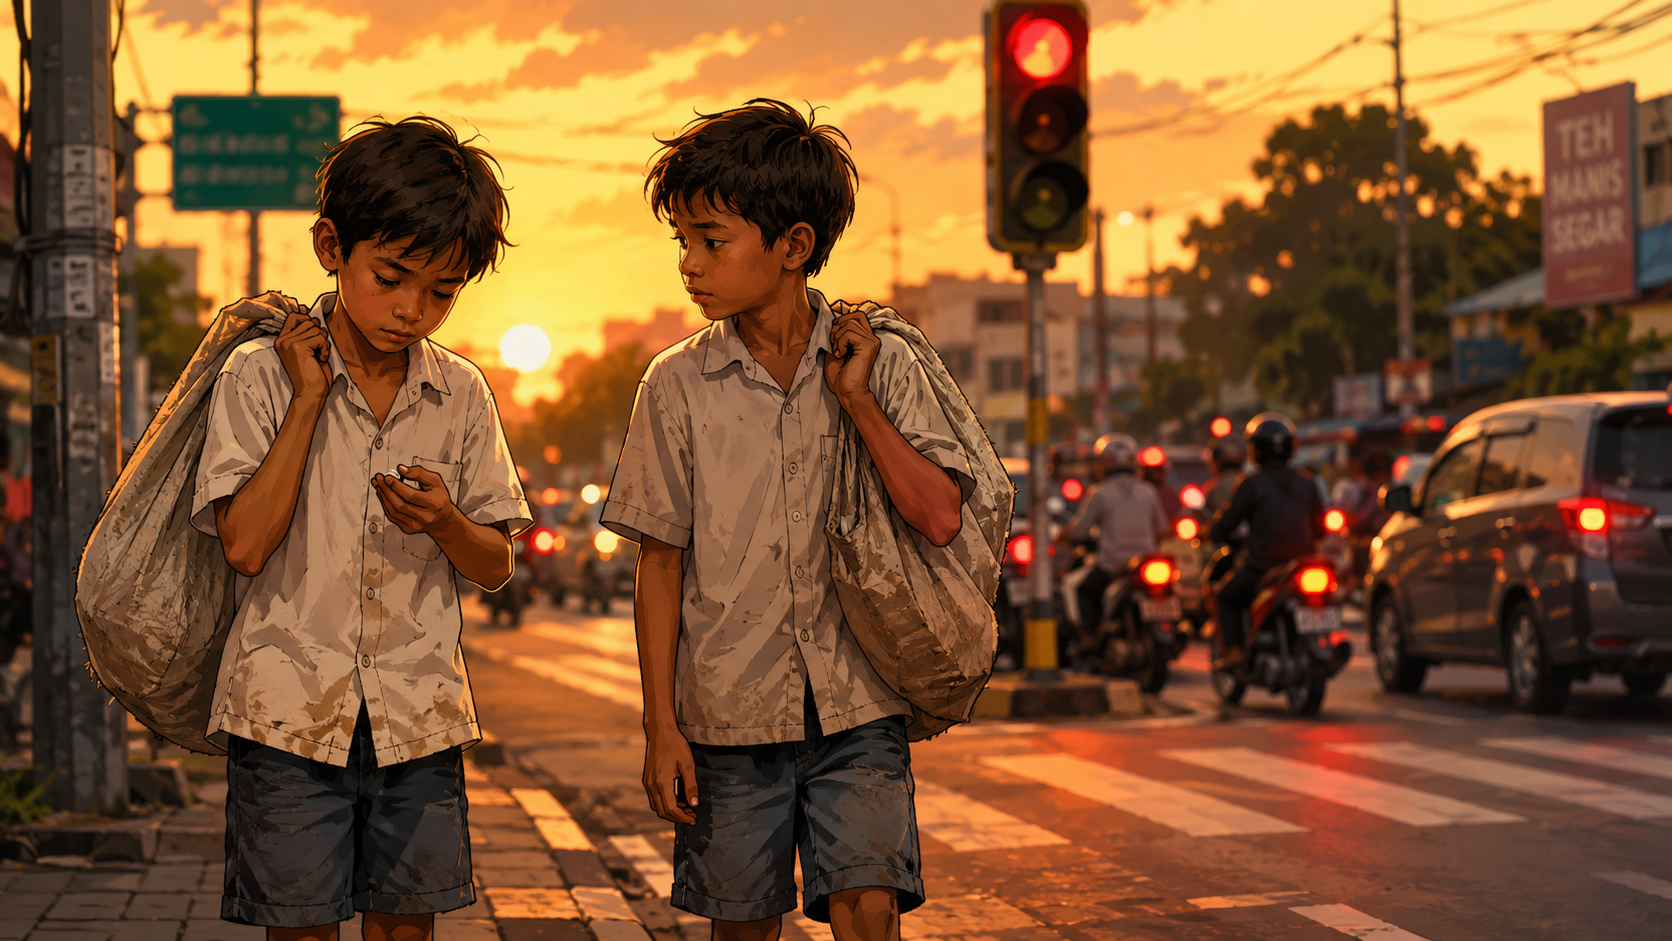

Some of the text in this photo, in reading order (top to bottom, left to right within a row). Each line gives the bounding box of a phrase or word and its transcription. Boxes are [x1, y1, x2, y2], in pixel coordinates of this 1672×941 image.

[1556, 110, 1615, 163] TEH
[1552, 159, 1624, 208] MANIS
[1552, 207, 1625, 254] SEGAR
